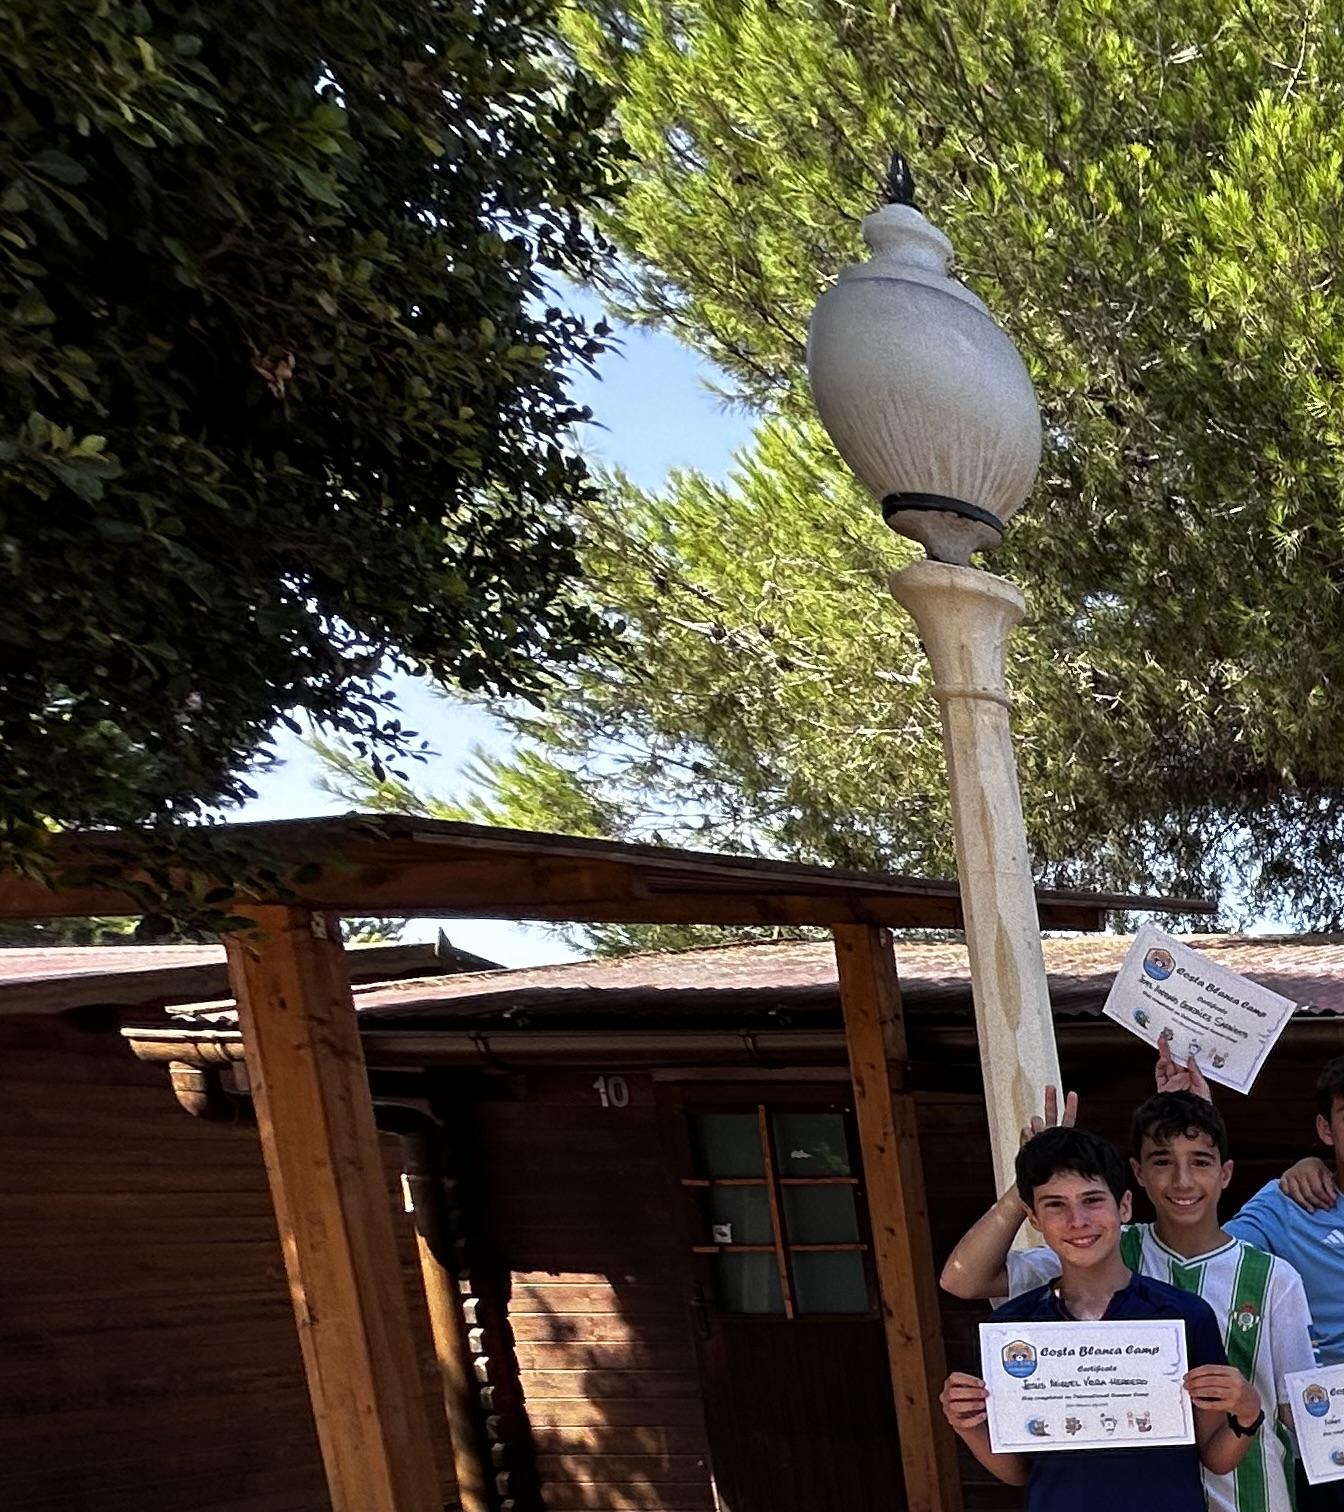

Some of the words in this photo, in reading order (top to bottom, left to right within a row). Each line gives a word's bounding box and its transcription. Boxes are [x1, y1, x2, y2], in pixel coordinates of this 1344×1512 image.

[1177, 967, 1205, 987] Costa
[1206, 983, 1240, 1006] Blanca
[1241, 1001, 1267, 1018] Camp
[593, 1076, 629, 1107] 10
[1040, 1347, 1075, 1357] Costa
[1079, 1346, 1122, 1356] Blanca
[1126, 1345, 1159, 1355] Camp
